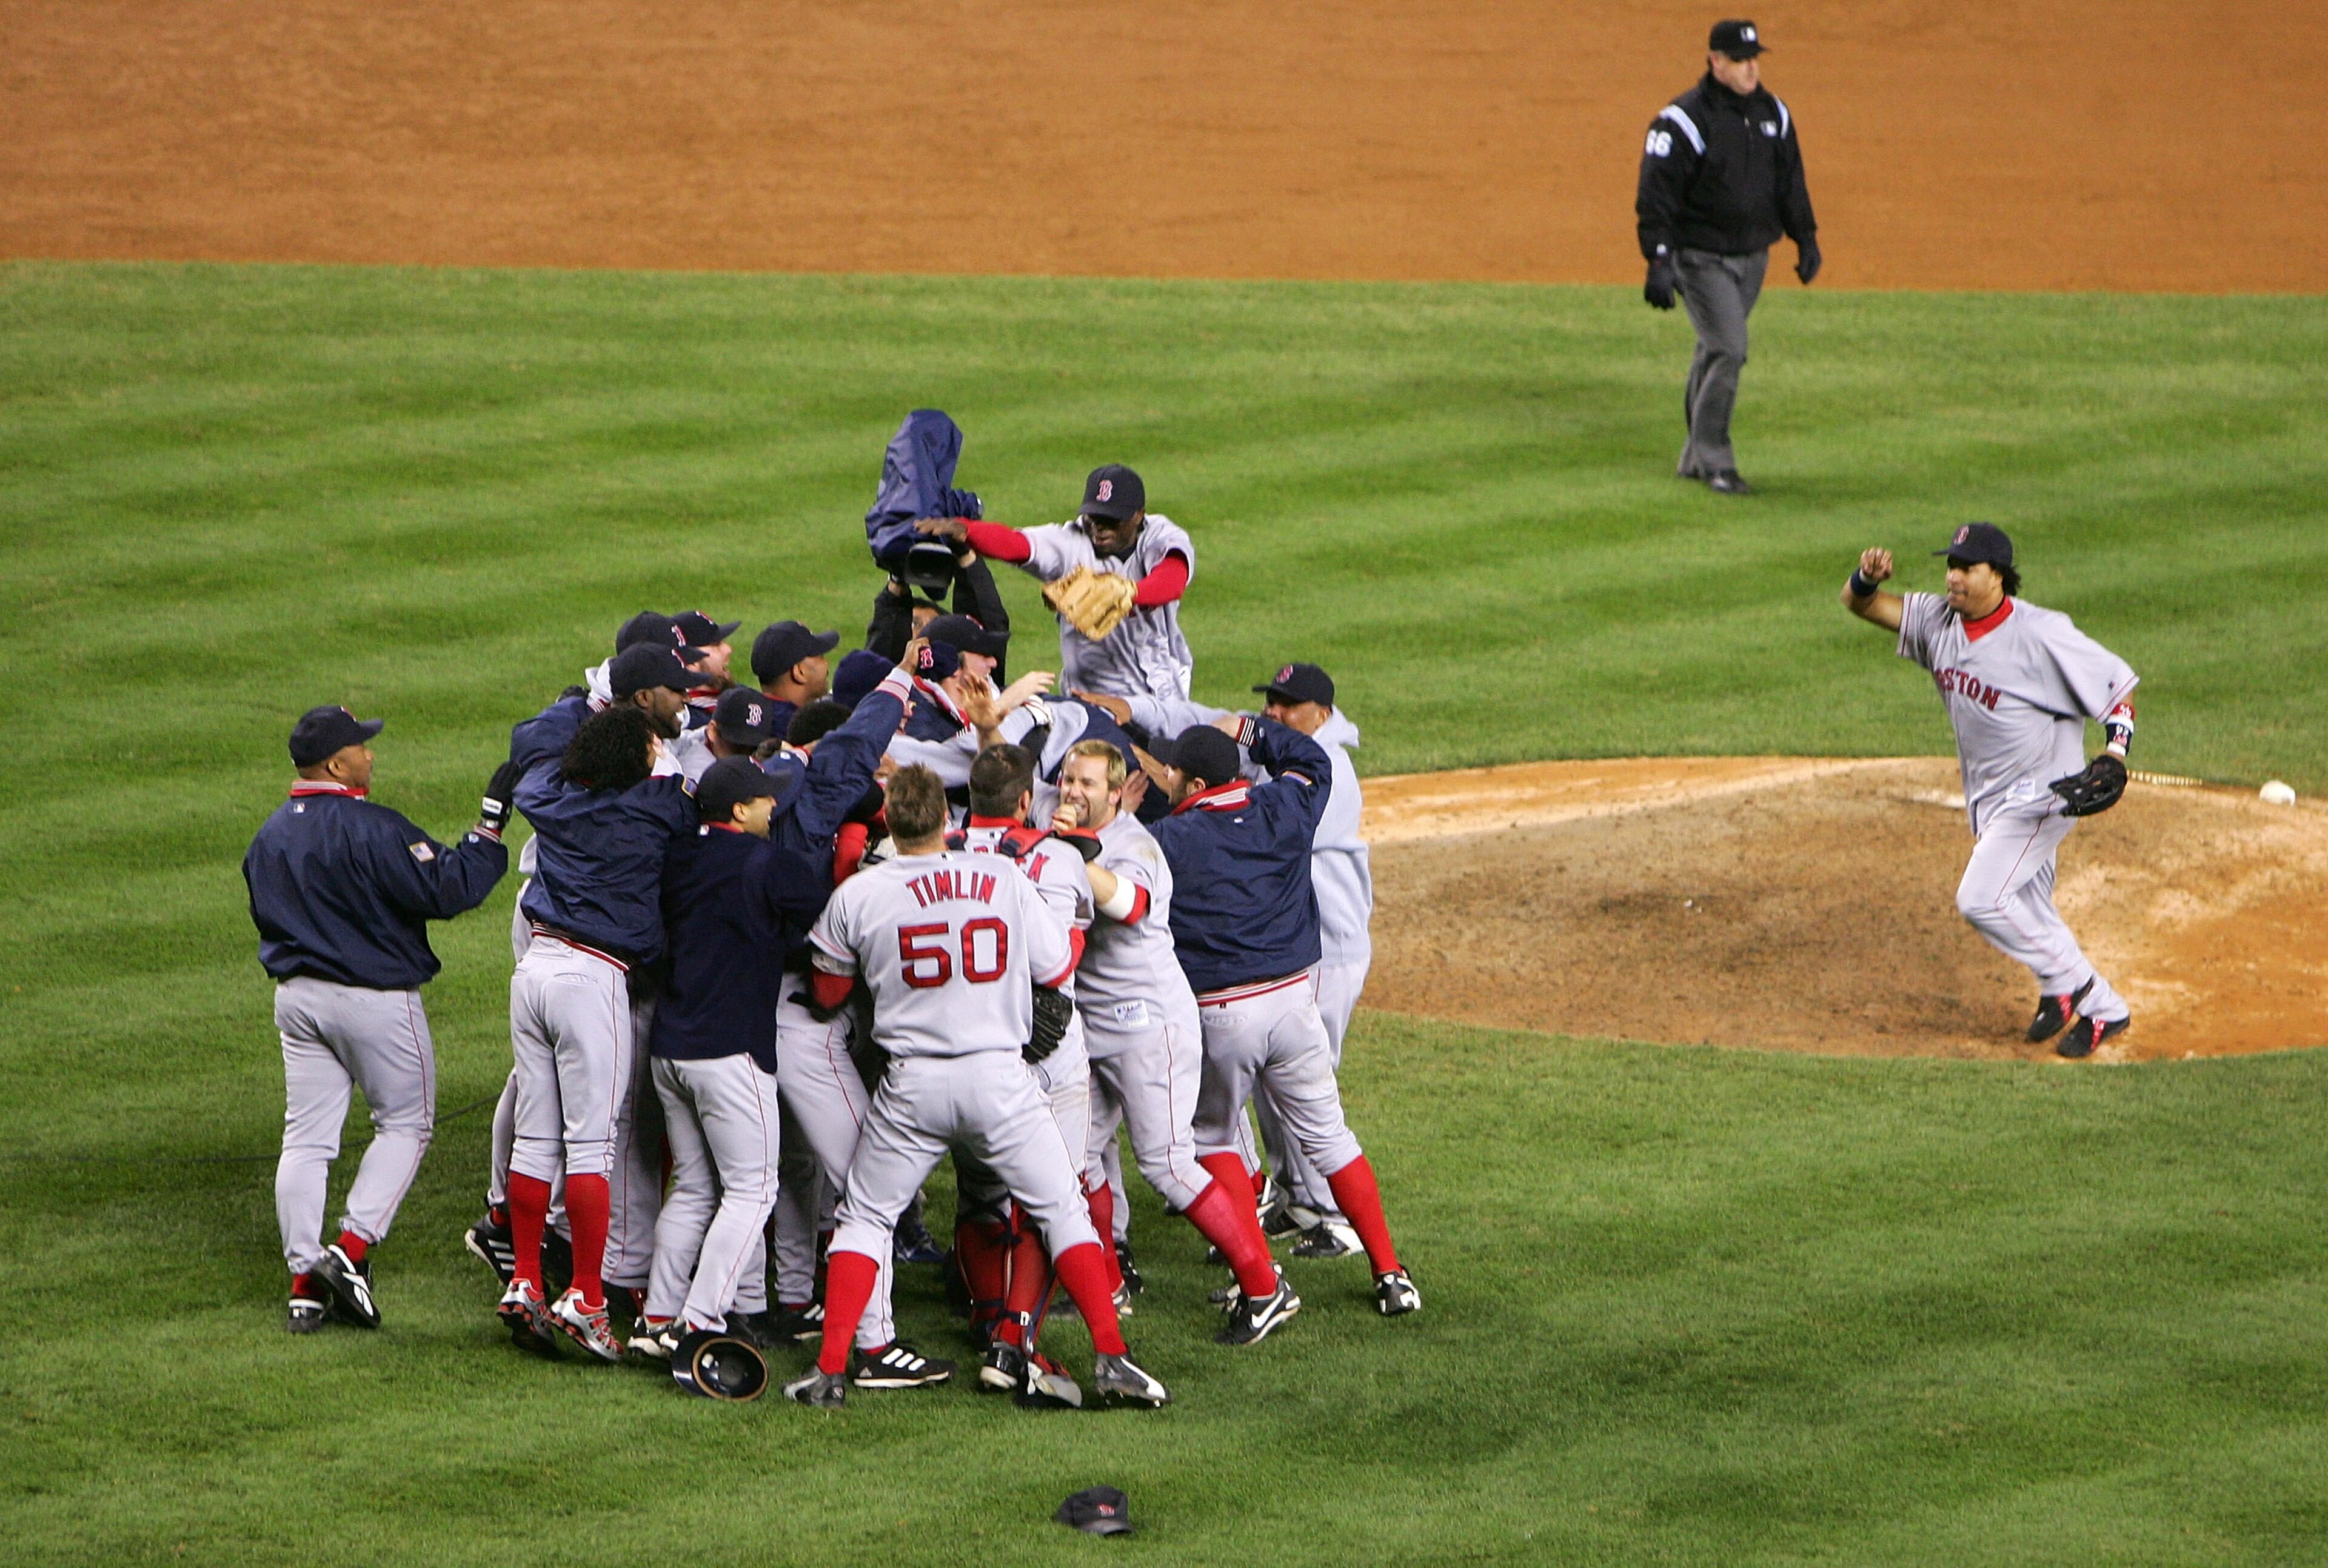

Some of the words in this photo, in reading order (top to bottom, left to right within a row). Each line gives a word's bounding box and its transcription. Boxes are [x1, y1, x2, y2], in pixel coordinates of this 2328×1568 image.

[1096, 479, 1113, 502] B
[920, 648, 934, 669] B
[746, 703, 762, 726] B
[905, 869, 997, 908] TIMLIN
[898, 917, 1008, 988] 50
